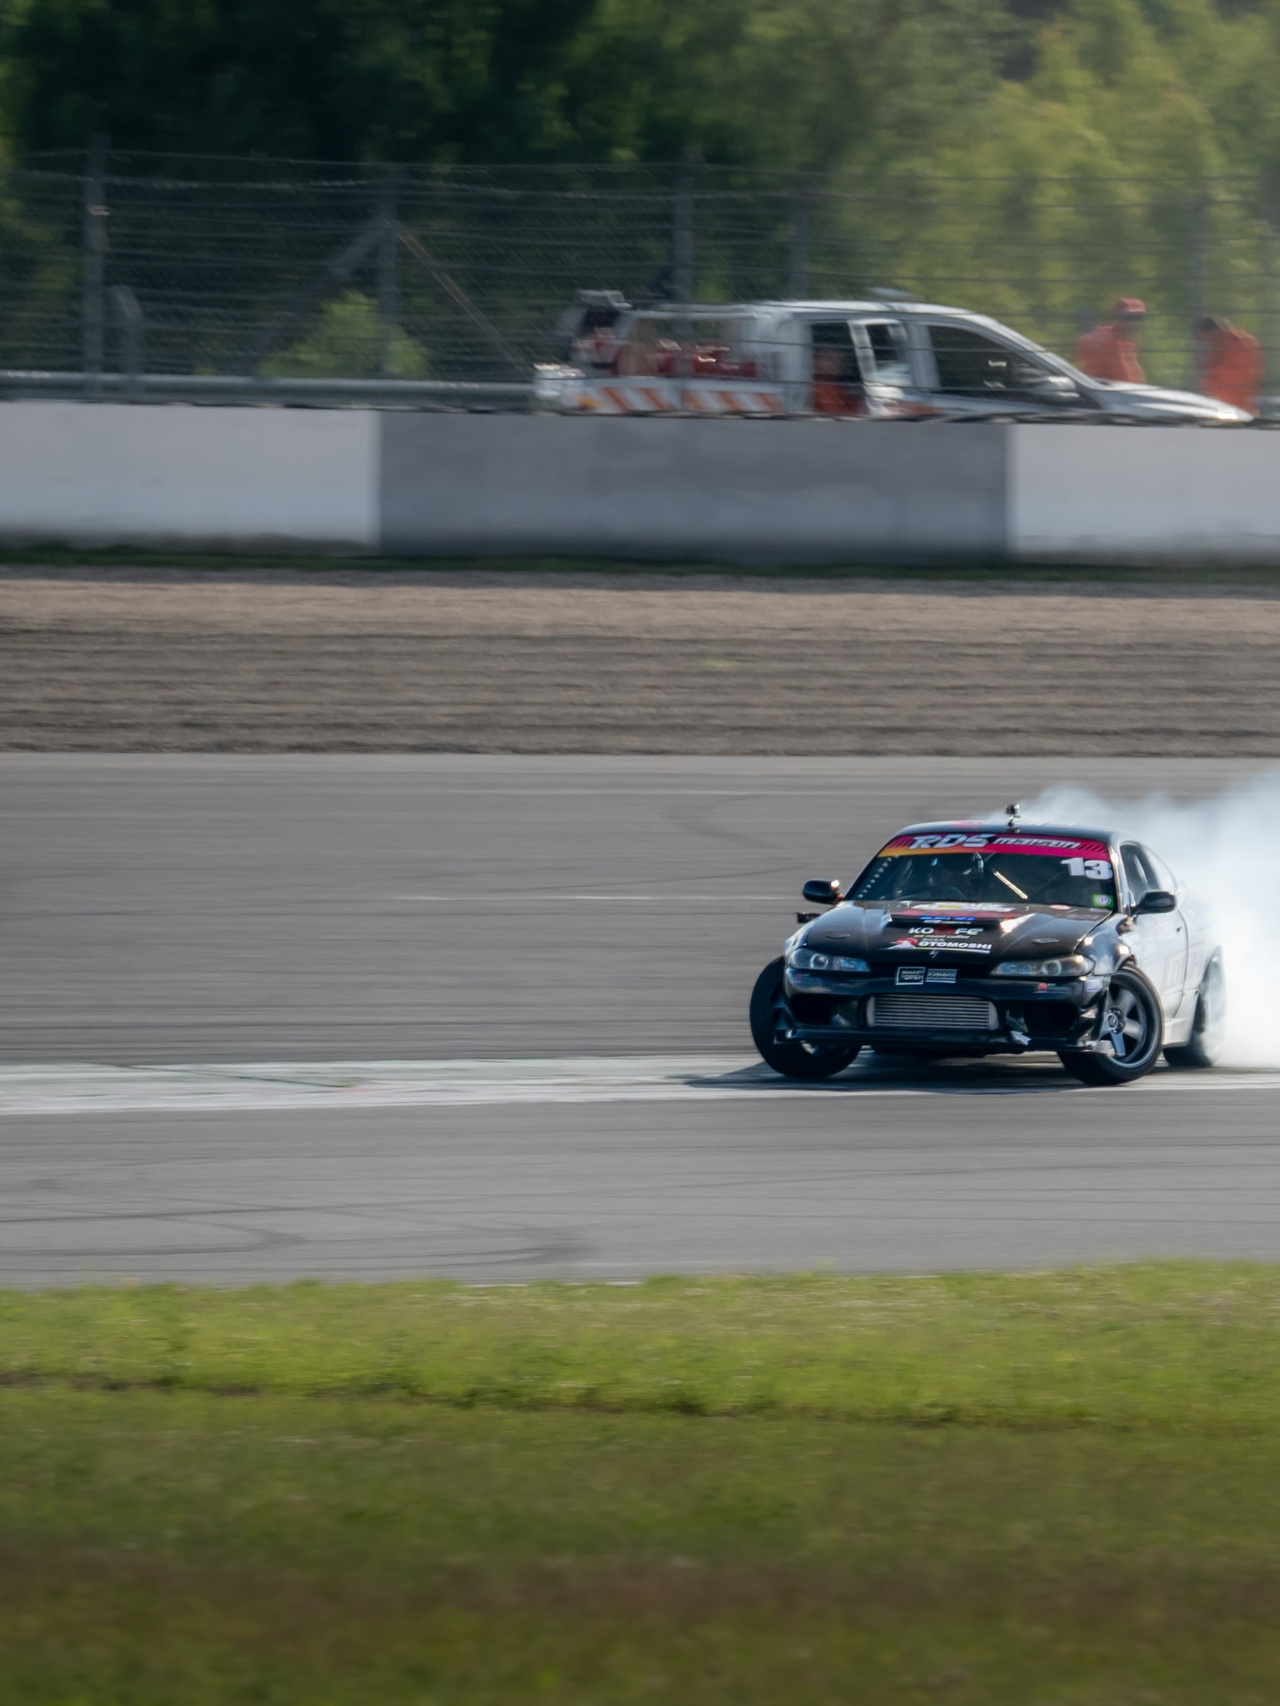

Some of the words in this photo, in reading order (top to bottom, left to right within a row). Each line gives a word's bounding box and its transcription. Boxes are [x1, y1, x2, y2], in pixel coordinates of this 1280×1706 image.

[908, 834, 997, 850] RDS
[1060, 858, 1113, 880] 13
[919, 941, 992, 950] OTOMOSHI
